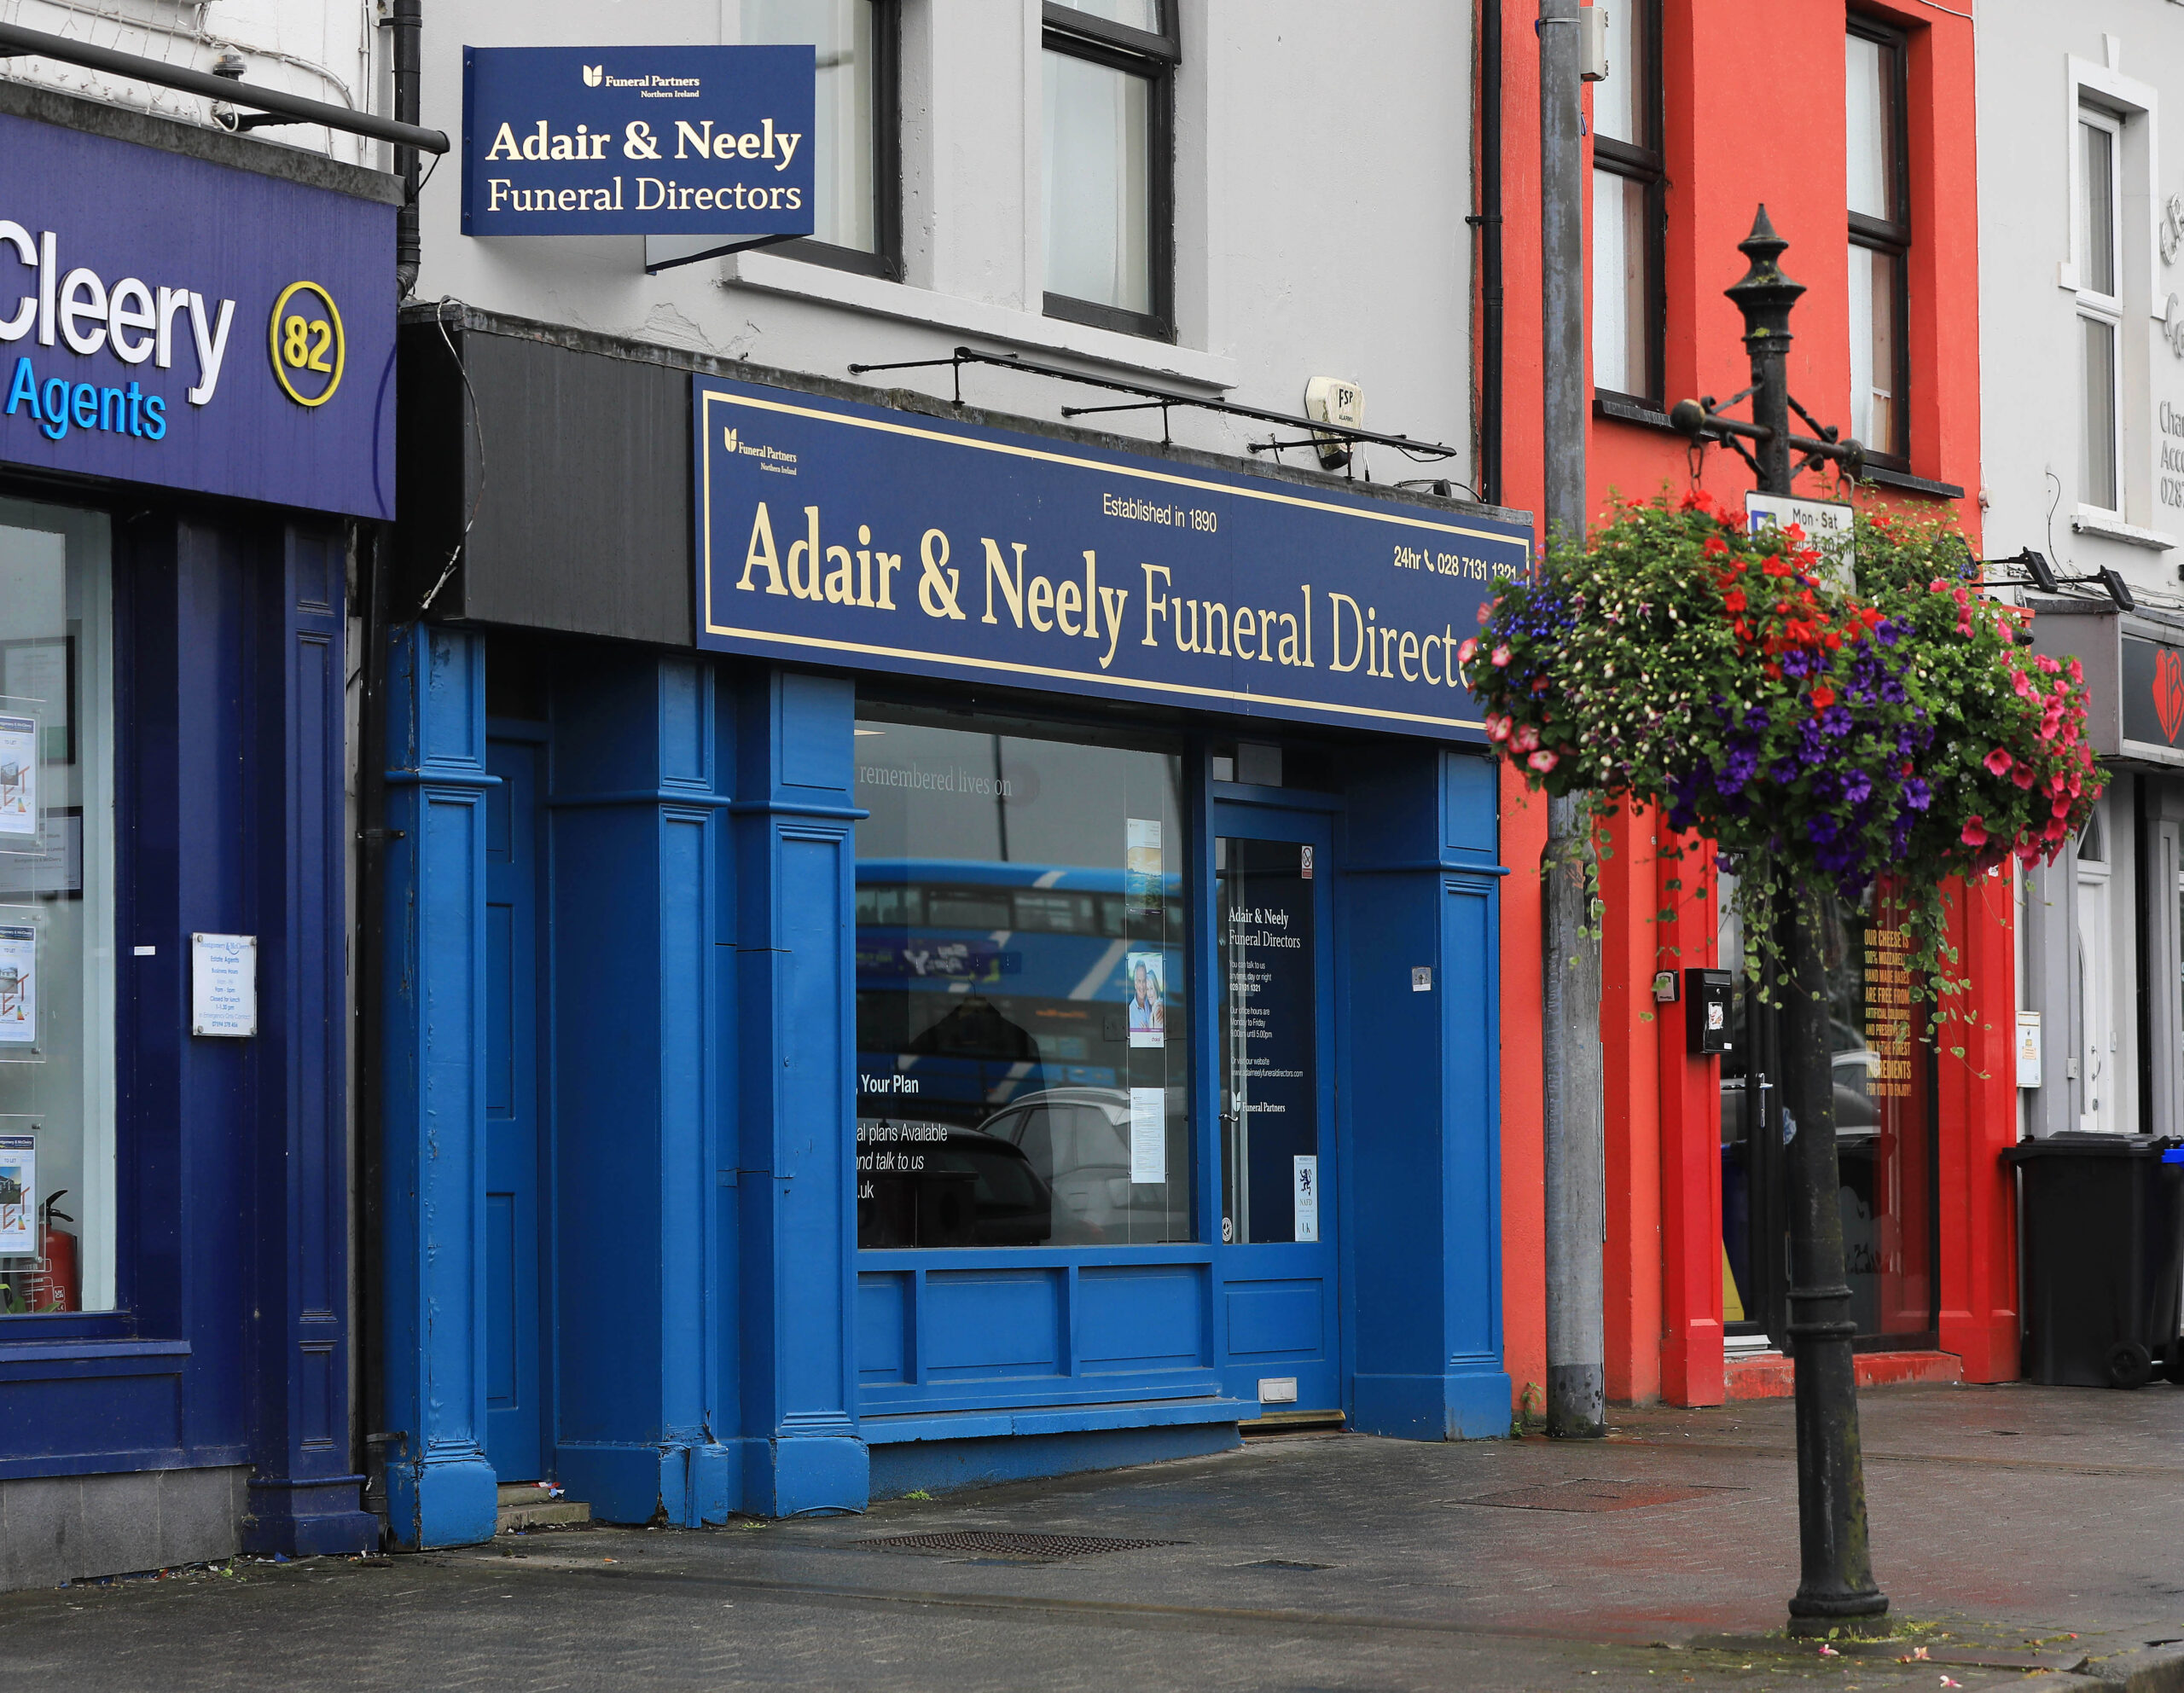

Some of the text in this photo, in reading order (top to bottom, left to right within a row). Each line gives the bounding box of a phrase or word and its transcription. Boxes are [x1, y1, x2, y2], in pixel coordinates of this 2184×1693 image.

[605, 75, 700, 87] Funeral Partners
[674, 90, 700, 98] Ireland
[485, 119, 802, 171] Adair & Neely
[487, 177, 802, 212] Funeral Directors
[283, 315, 332, 373] 82
[7, 357, 166, 440] Agents
[1339, 388, 1354, 408] FSP
[738, 441, 797, 463] Funeral Partners
[760, 461, 797, 476] Northern Ireland
[1103, 492, 1217, 533] Established in 1890
[1792, 507, 1814, 525] Mon
[1821, 512, 1838, 530] Sat
[1393, 545, 1421, 570] 24hr
[1437, 553, 1460, 577] 028
[1461, 556, 1487, 581] 7131
[736, 502, 901, 611] Adair
[918, 528, 966, 620] &
[981, 537, 1128, 670] Neely
[1141, 563, 1315, 667] Funeral
[860, 762, 1013, 797] remembered lives on
[1228, 907, 1289, 930] Adair & Neely
[1229, 929, 1301, 948] Funeral Directors
[1864, 929, 1877, 946] OUR
[1878, 930, 1902, 948] CHEESE
[1879, 951, 1906, 965] MOZZARELL
[1864, 968, 1879, 982] HAND
[1879, 970, 1893, 983] MADE
[1251, 983, 1261, 992] 1321
[1865, 987, 1910, 1005] ARE FREE FROM
[1251, 1007, 1263, 1016] hours
[1253, 1018, 1266, 1029] Friday
[1865, 1023, 1875, 1035] AND
[1866, 1059, 1911, 1080] INGREDIENTS
[861, 1074, 919, 1093] Your Plan
[1242, 1101, 1286, 1112] Funeral Partners
[869, 1123, 897, 1145] plans
[901, 1122, 948, 1141] Available
[876, 1151, 894, 1169] talk
[898, 1153, 909, 1169] to
[911, 1156, 925, 1169] us
